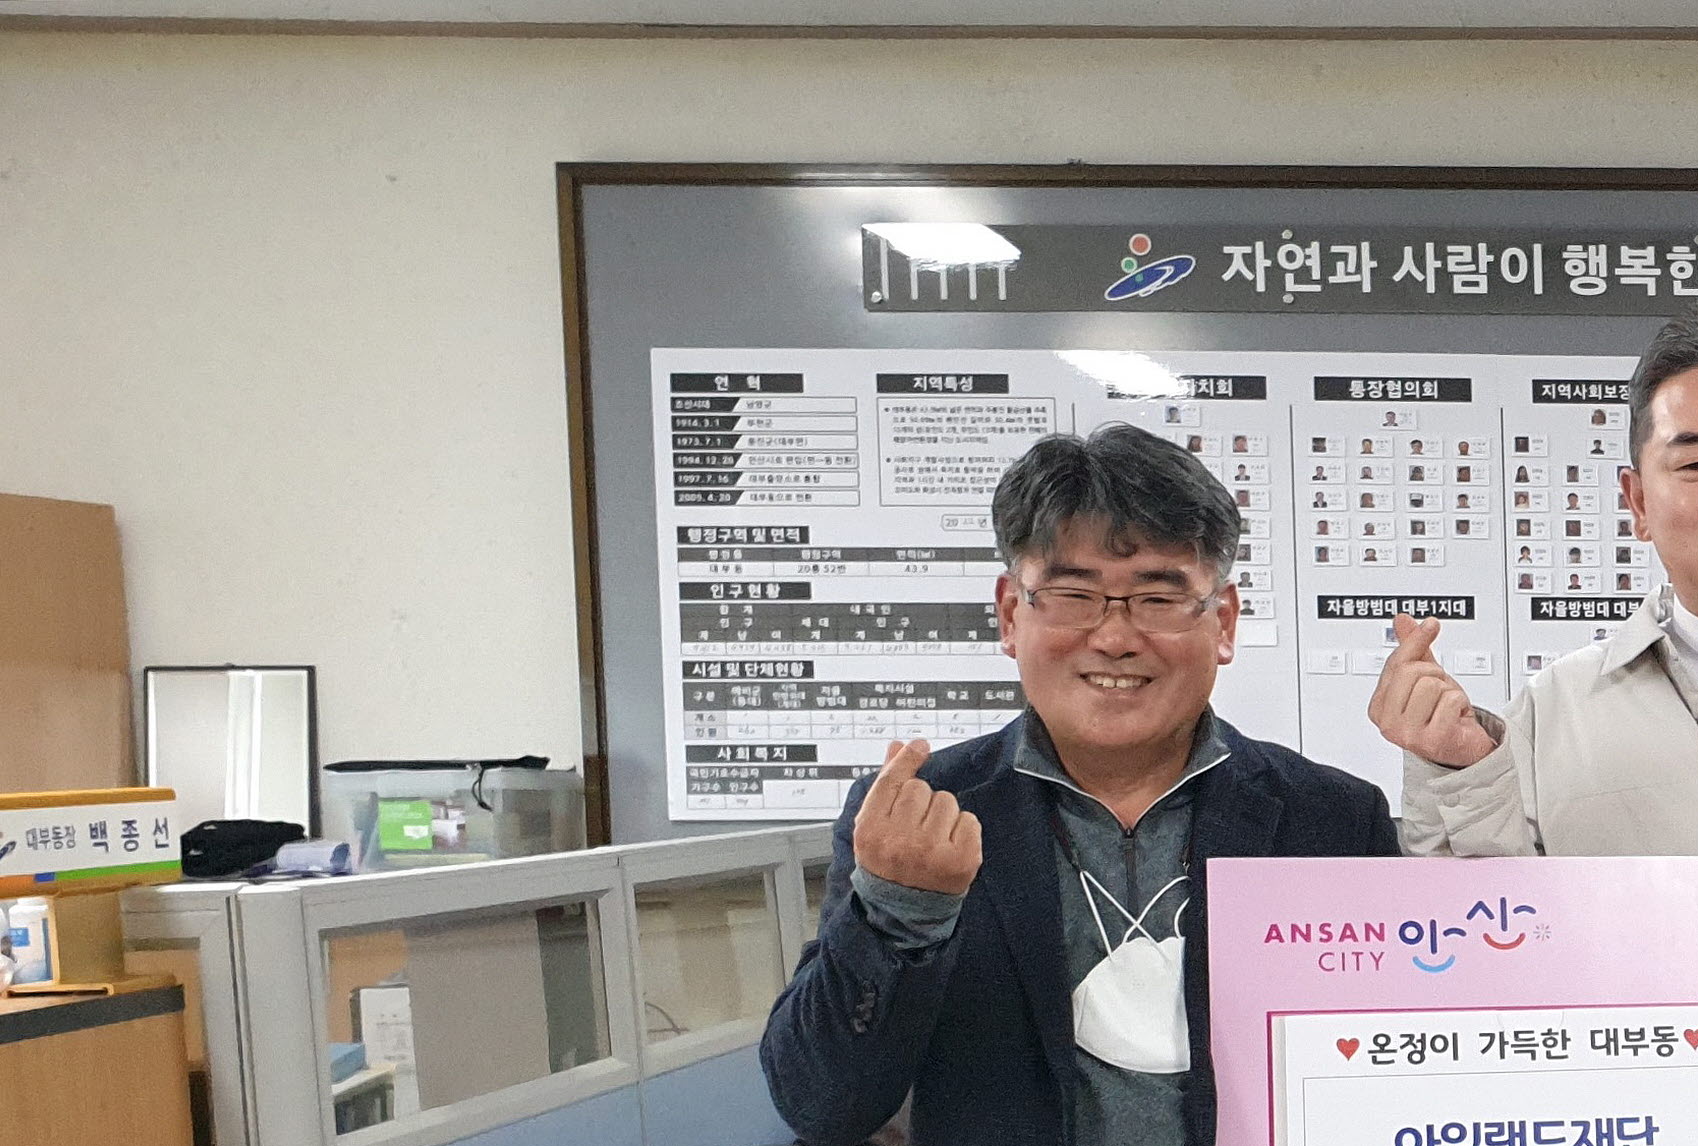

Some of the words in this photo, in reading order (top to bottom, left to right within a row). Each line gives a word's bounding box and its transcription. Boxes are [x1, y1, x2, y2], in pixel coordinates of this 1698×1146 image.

[1222, 240, 1377, 293] 자연과
[1393, 241, 1543, 295] 사람이
[913, 376, 973, 392] 지역특성
[1350, 380, 1438, 399] 통장협의회
[687, 527, 748, 543] 행정구역
[752, 528, 766, 543] 및
[770, 528, 800, 543] 면적
[710, 583, 780, 599] 인구현황
[1327, 599, 1398, 616] 자율방범대
[1402, 599, 1467, 616] 대부1지대
[1540, 600, 1610, 618] 자율방범대
[692, 663, 722, 678] 시설
[726, 663, 740, 678] 및
[744, 663, 804, 678] 단체현황
[717, 746, 787, 761] 사회복지
[25, 825, 77, 850] 대부동장
[1264, 922, 1386, 944] ANSAN
[1318, 951, 1385, 972] CITY
[1367, 1032, 1460, 1066] 온정이
[1478, 1027, 1572, 1061] 가득한
[1590, 1025, 1680, 1058] 대부동
